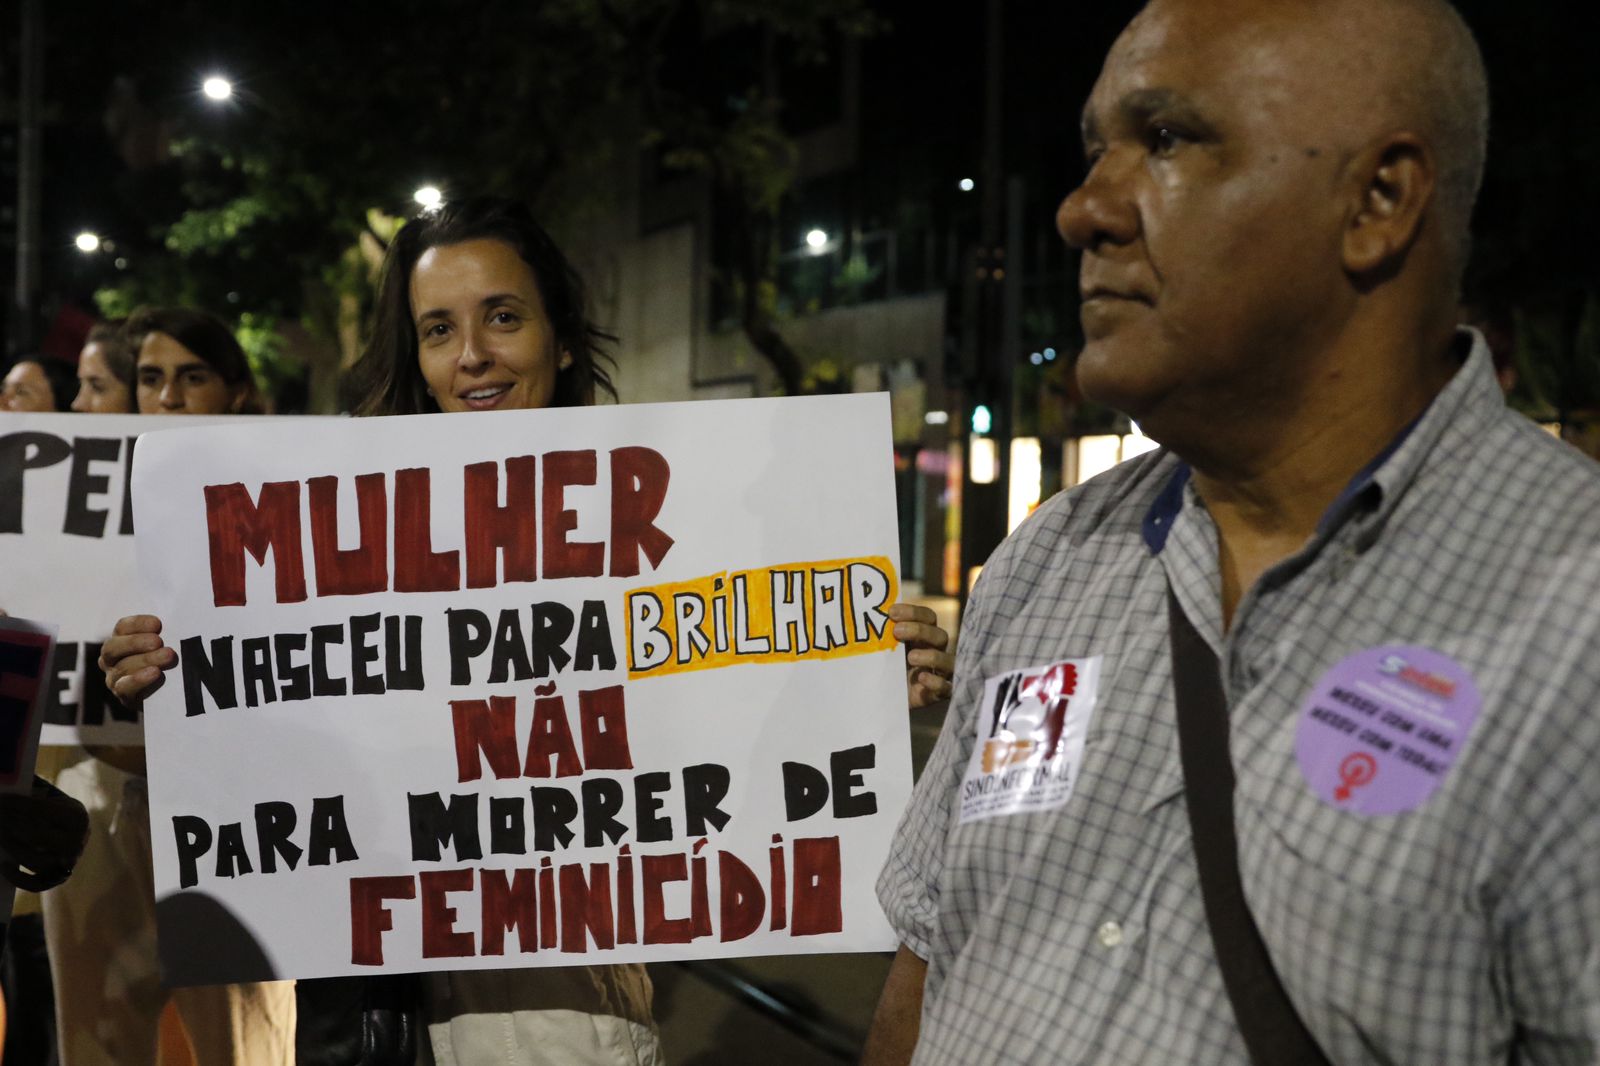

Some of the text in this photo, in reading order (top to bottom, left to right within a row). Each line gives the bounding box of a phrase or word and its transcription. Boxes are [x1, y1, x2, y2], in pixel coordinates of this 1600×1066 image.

[204, 446, 675, 607] MULHER
[180, 612, 424, 717] NASCEU
[444, 600, 616, 686] PARA
[448, 680, 634, 783] NÃO
[172, 743, 877, 889] PARA MORRER DE
